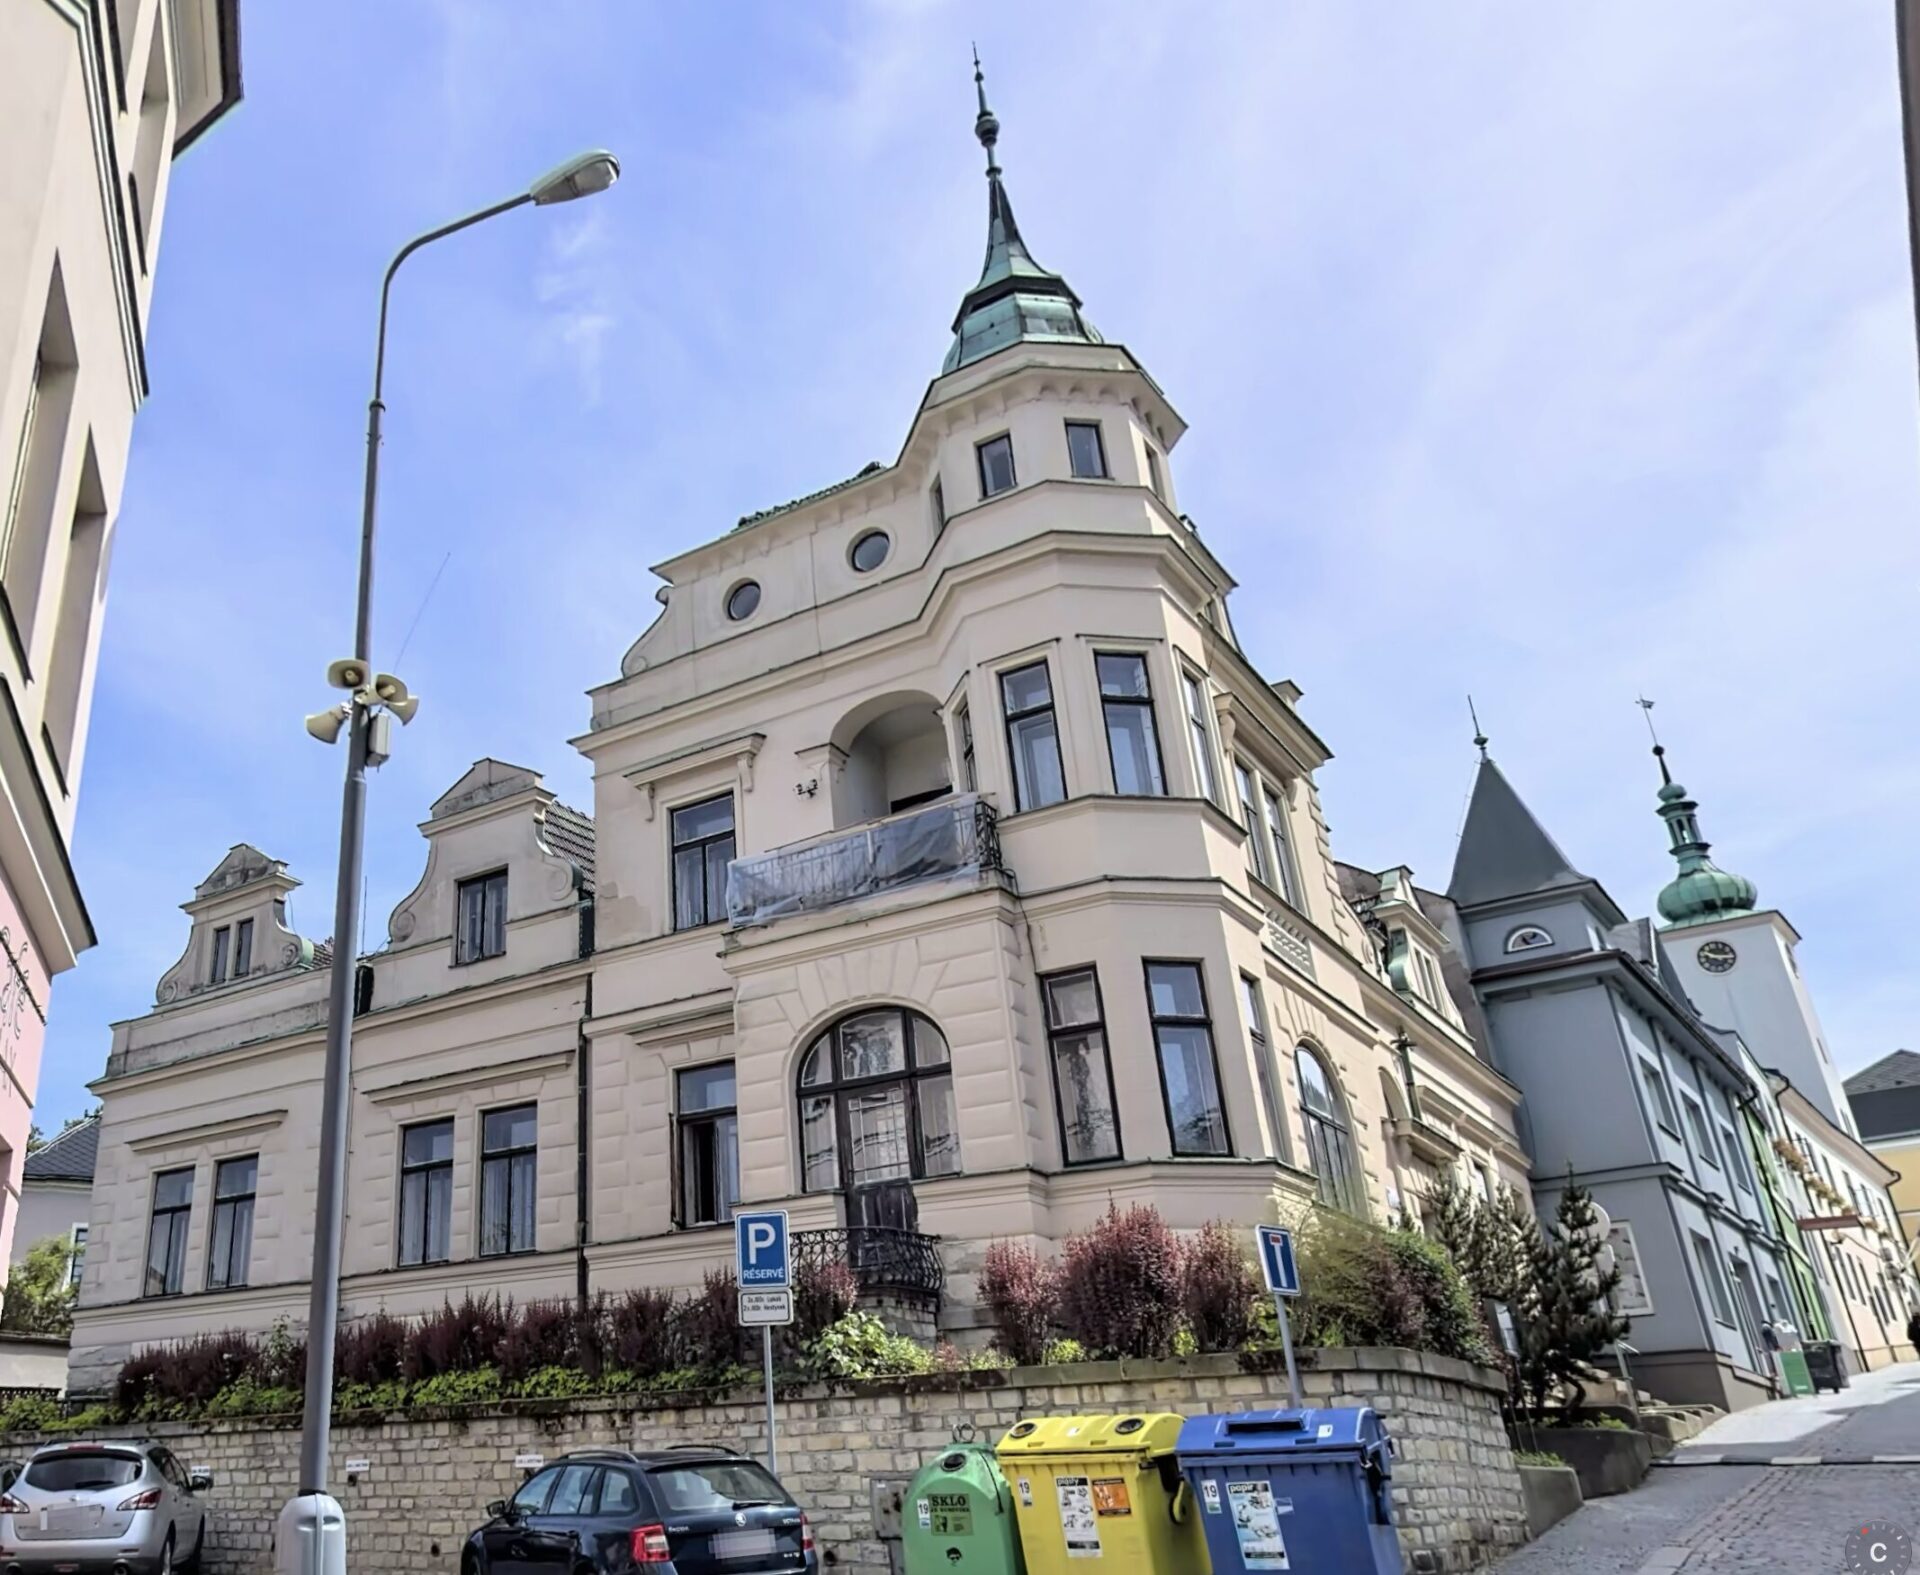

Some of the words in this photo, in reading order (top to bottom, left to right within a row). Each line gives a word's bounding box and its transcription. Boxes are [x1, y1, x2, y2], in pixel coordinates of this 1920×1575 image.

[748, 1222, 776, 1264] P
[743, 1267, 784, 1279] RÉSERVÉ
[1019, 1482, 1030, 1494] 19
[1204, 1485, 1217, 1498] 19
[931, 1496, 966, 1506] SKLO
[918, 1503, 928, 1514] 19
